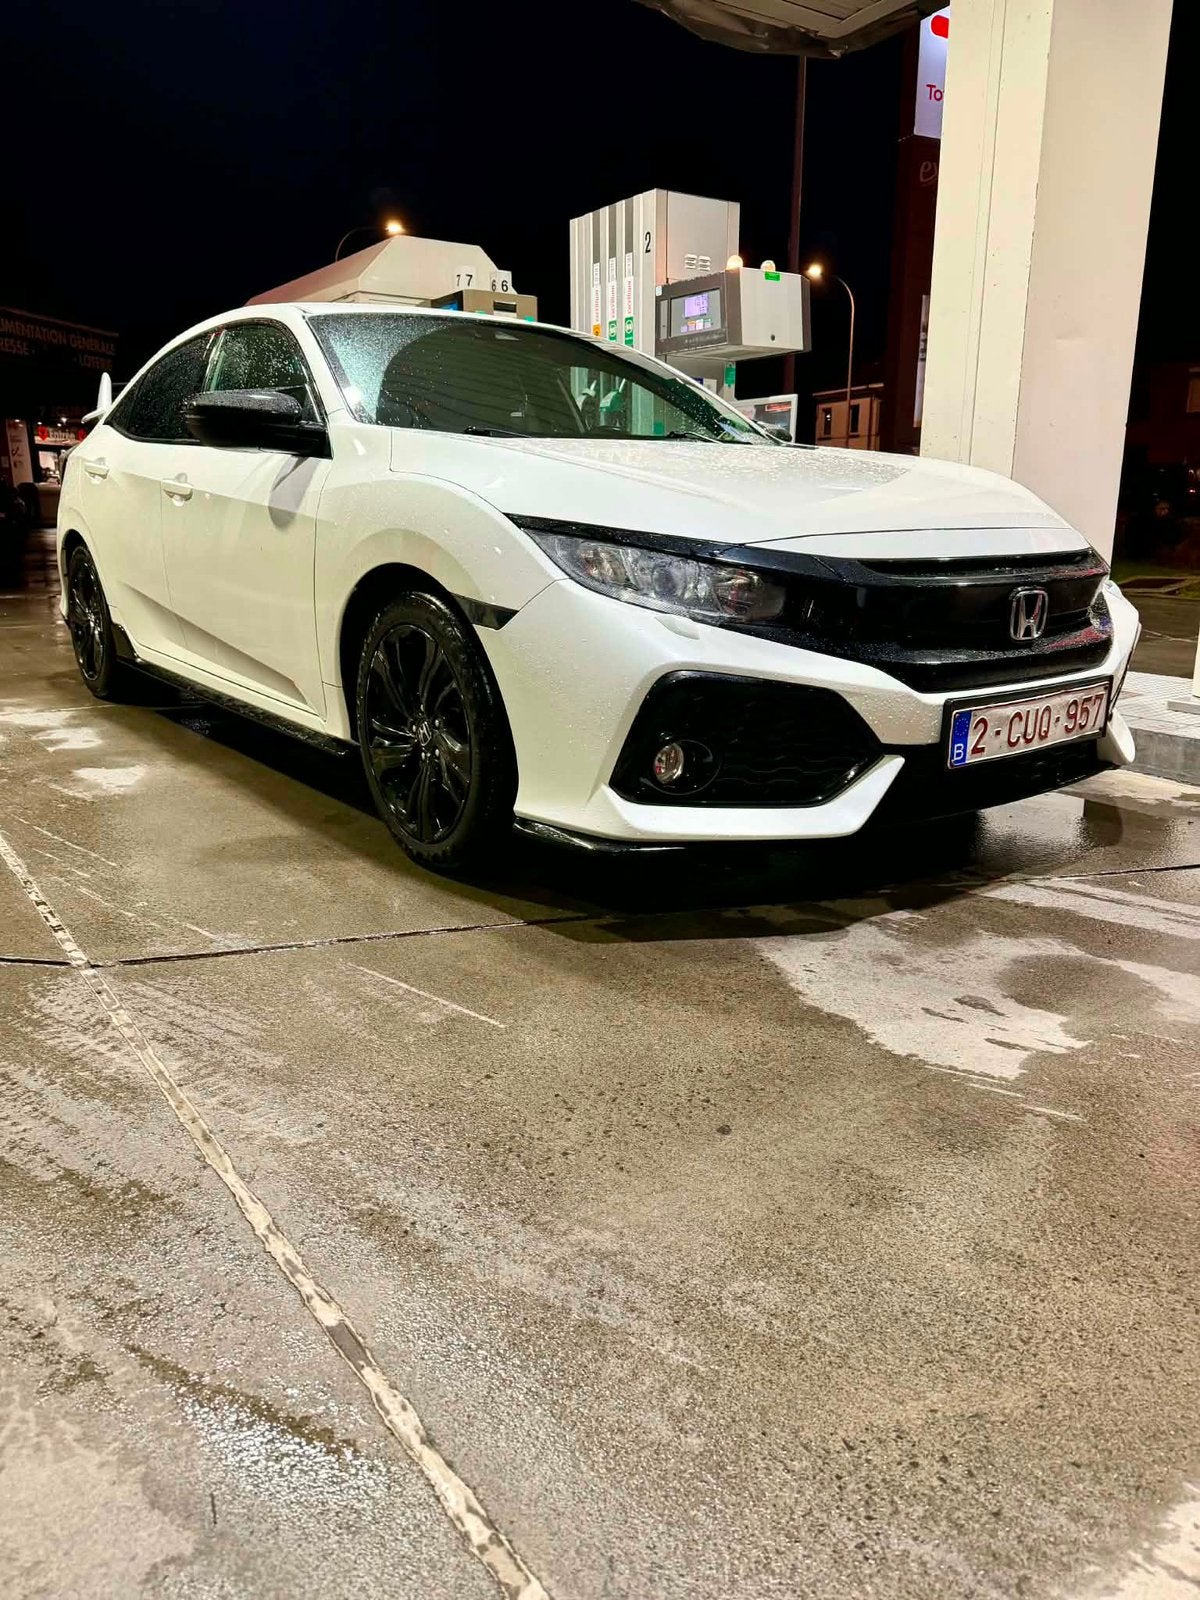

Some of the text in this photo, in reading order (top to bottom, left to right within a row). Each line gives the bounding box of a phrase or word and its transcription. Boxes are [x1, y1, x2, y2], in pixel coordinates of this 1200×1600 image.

[926, 84, 944, 101] To
[644, 231, 651, 253] 2
[465, 274, 473, 287] 7
[501, 279, 509, 293] 6
[953, 743, 965, 761] B
